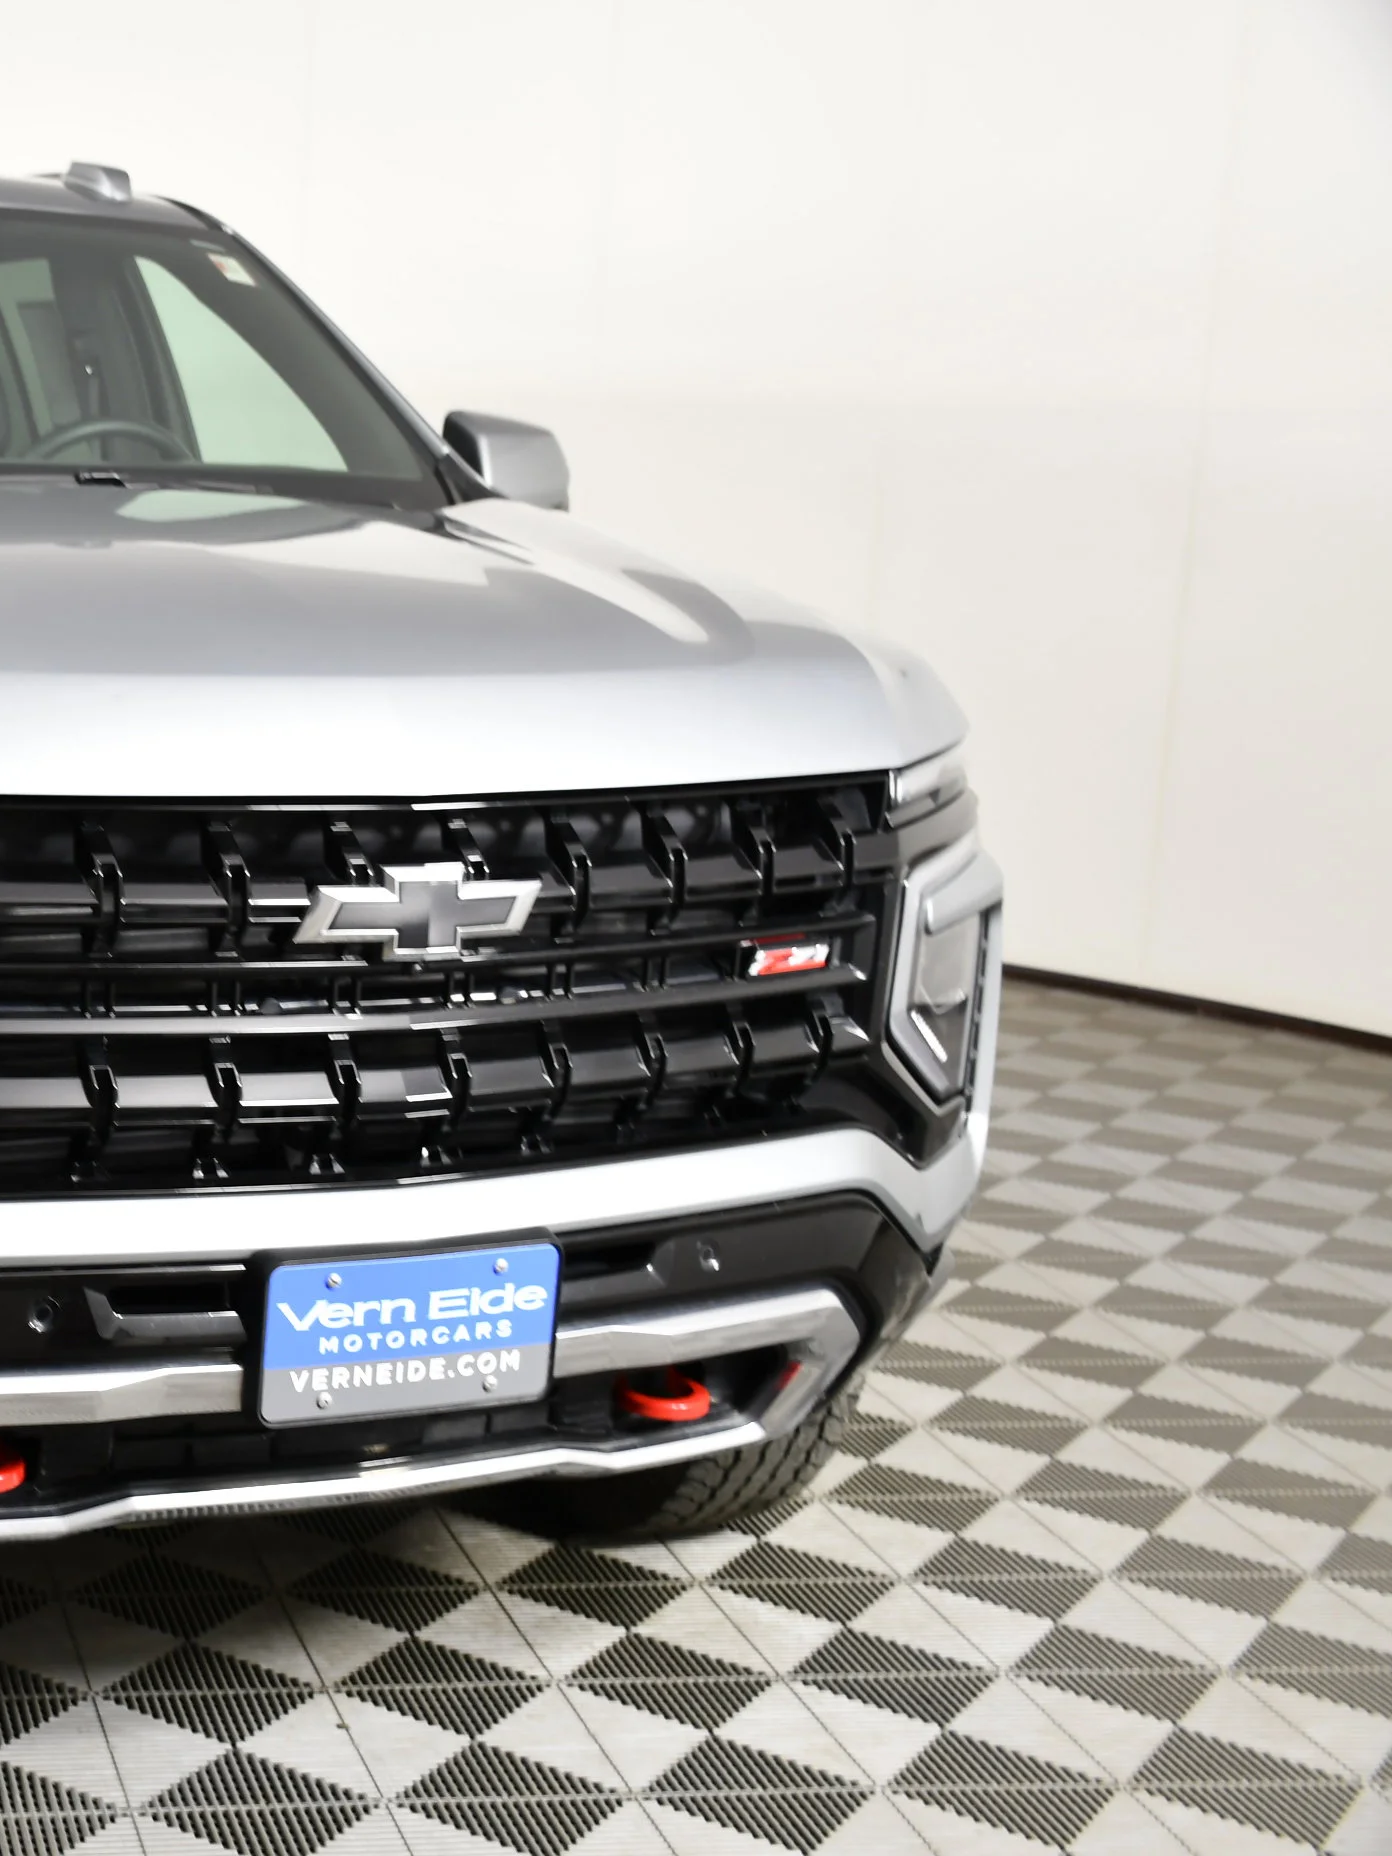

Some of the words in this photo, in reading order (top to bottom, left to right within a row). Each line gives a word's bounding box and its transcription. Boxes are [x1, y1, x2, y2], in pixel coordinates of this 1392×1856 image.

[276, 1296, 416, 1332] Vern
[428, 1282, 548, 1321] Eide
[318, 1319, 513, 1355] MOTORCARS
[289, 1349, 521, 1393] VERNEIDE.COM
